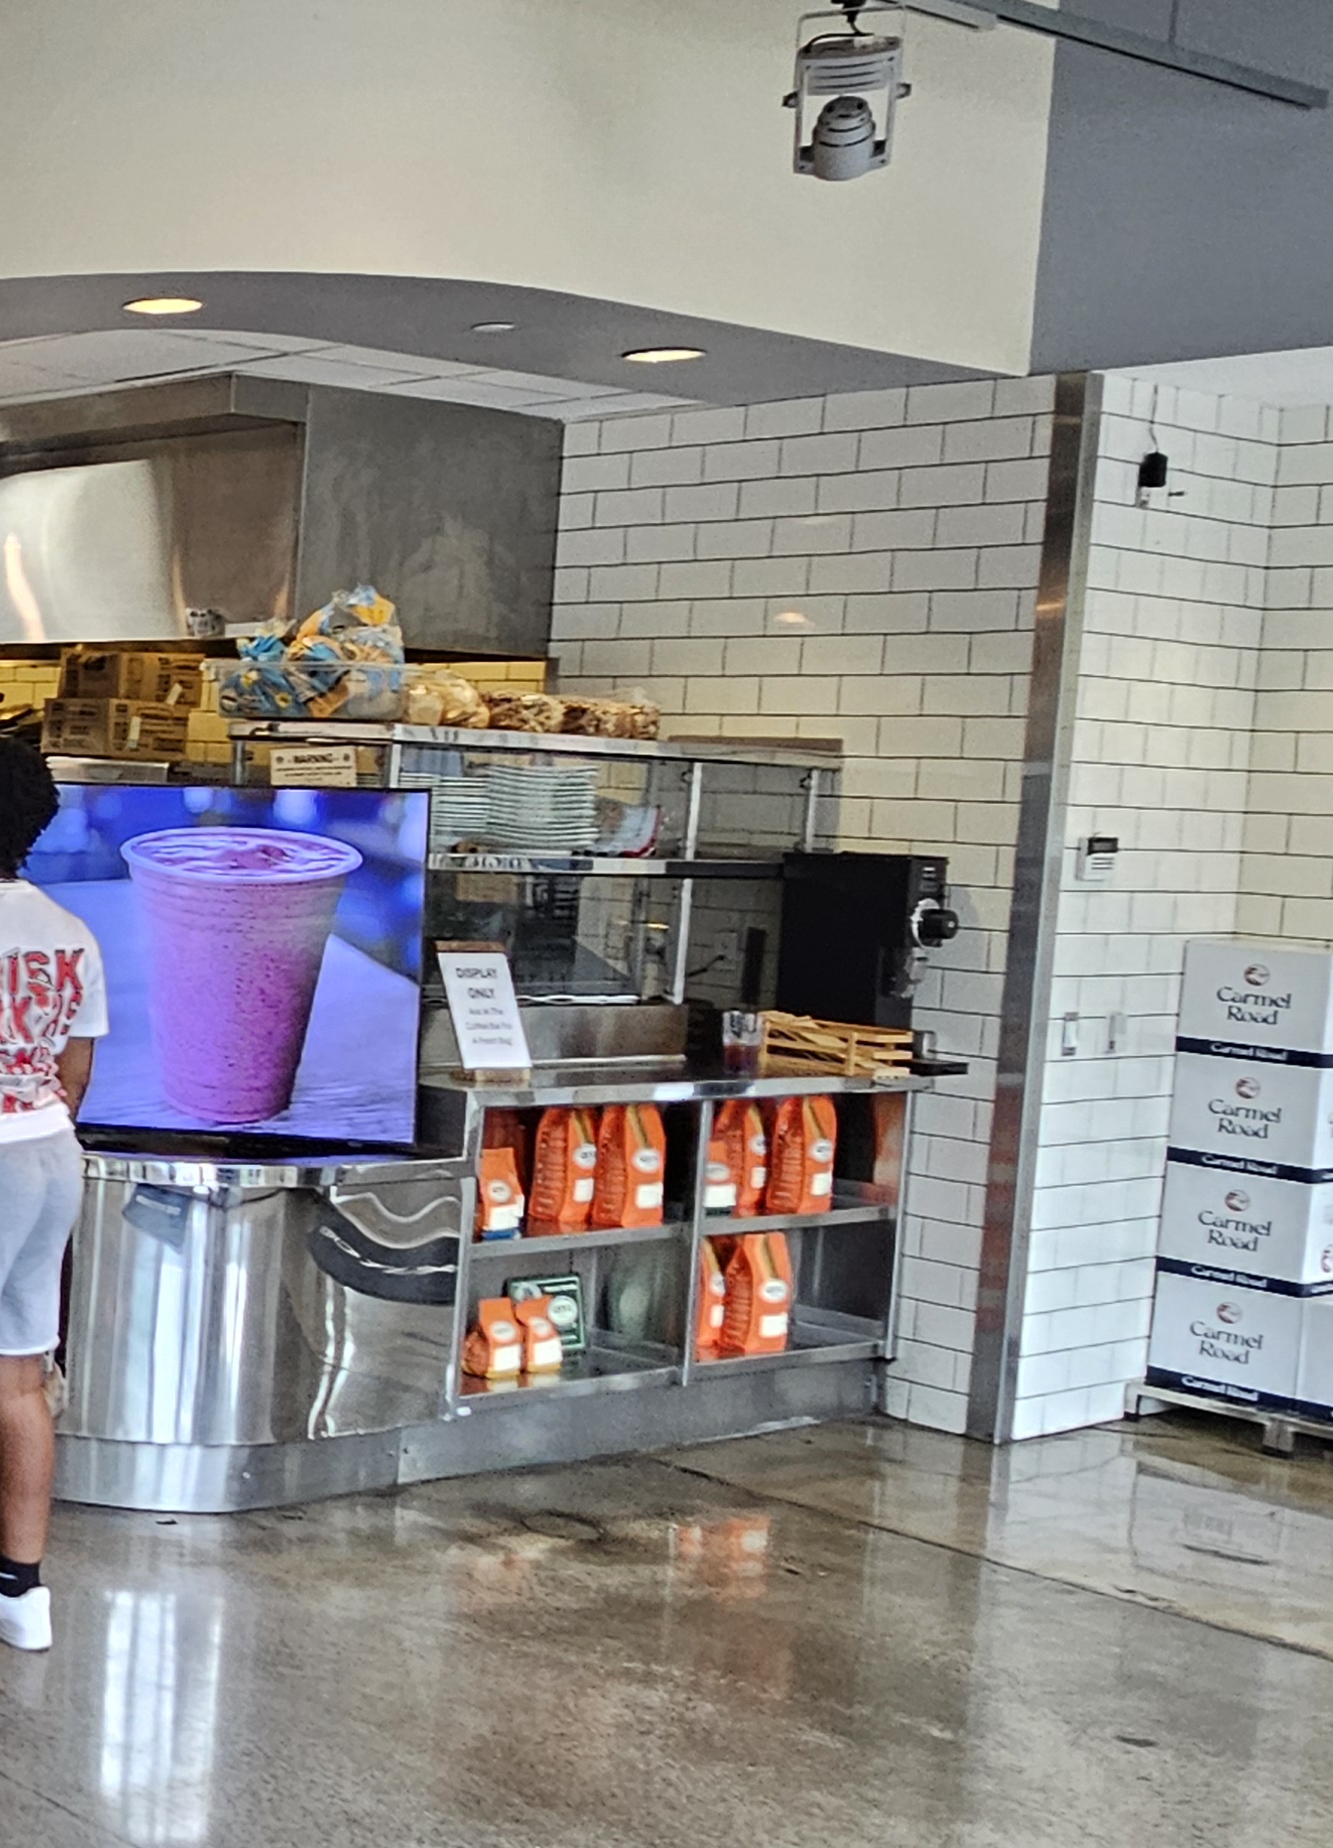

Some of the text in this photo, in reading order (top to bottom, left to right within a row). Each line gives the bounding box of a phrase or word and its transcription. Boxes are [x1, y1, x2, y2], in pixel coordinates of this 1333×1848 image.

[455, 967, 497, 979] DISPLAY
[468, 987, 495, 999] ONLY
[1216, 986, 1292, 1009] Carmel
[1226, 1005, 1278, 1025] Road
[1208, 1099, 1282, 1123] Carmel
[1217, 1117, 1269, 1139] Road
[1198, 1210, 1272, 1237] Carmel
[1207, 1229, 1258, 1252] Road
[1190, 1321, 1264, 1349] Carmel
[1199, 1339, 1250, 1365] Road
